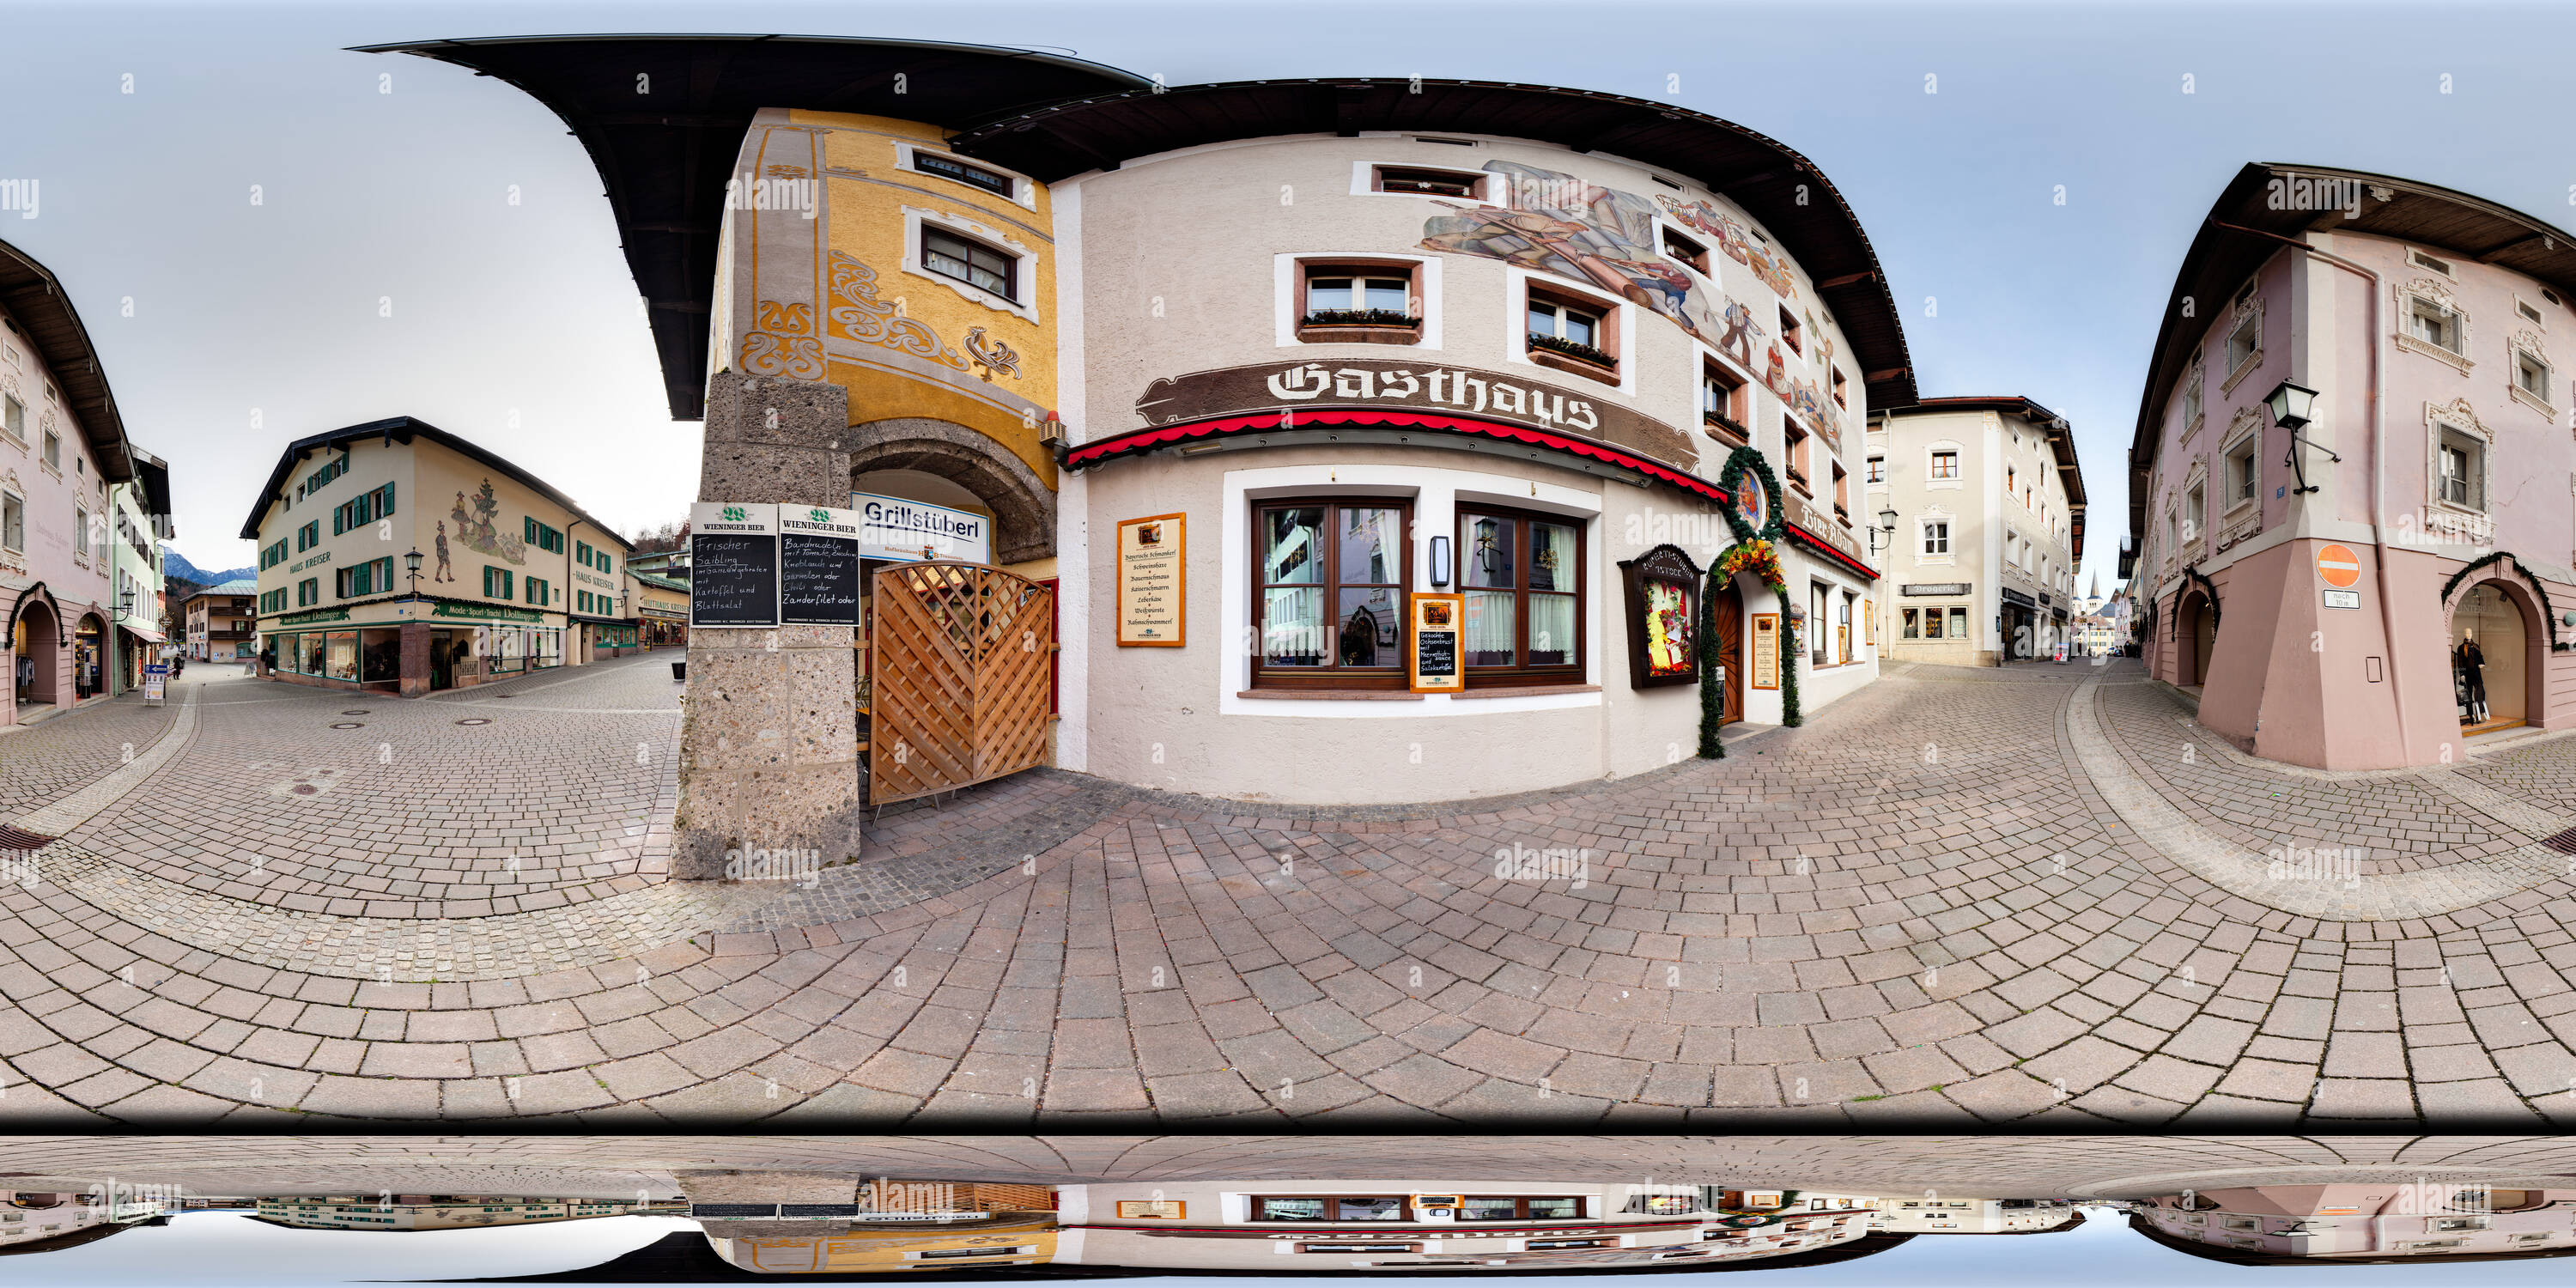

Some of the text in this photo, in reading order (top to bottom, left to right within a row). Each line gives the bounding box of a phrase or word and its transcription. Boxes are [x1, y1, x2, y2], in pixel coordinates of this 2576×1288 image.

[1267, 362, 1598, 430] Gasthaus
[865, 501, 978, 538] Grillstüberl
[783, 520, 835, 532] WIENINGER
[836, 524, 856, 534] BIER
[695, 537, 750, 552] Frischer
[785, 537, 841, 550] Bandnudeln
[1149, 550, 1176, 558] Schmankerl
[290, 552, 331, 574] HAUS KREISER
[696, 554, 737, 567] Saibling
[784, 559, 825, 568] Knoblauch
[1642, 550, 1694, 580] RUPERTI-STUBEN
[576, 570, 614, 590] HAUS KREISER
[824, 571, 840, 580] oder
[739, 585, 756, 594] und
[814, 582, 831, 591] oder
[1914, 585, 1955, 593] Drogerie
[644, 599, 669, 610] HUTHAUS
[694, 599, 742, 611] Blattsalat
[782, 594, 856, 606] Zanderfilet oder
[313, 611, 340, 622] Dollinger
[449, 606, 466, 614] Mode
[469, 607, 484, 617] Sport
[504, 609, 536, 622] Dollinger
